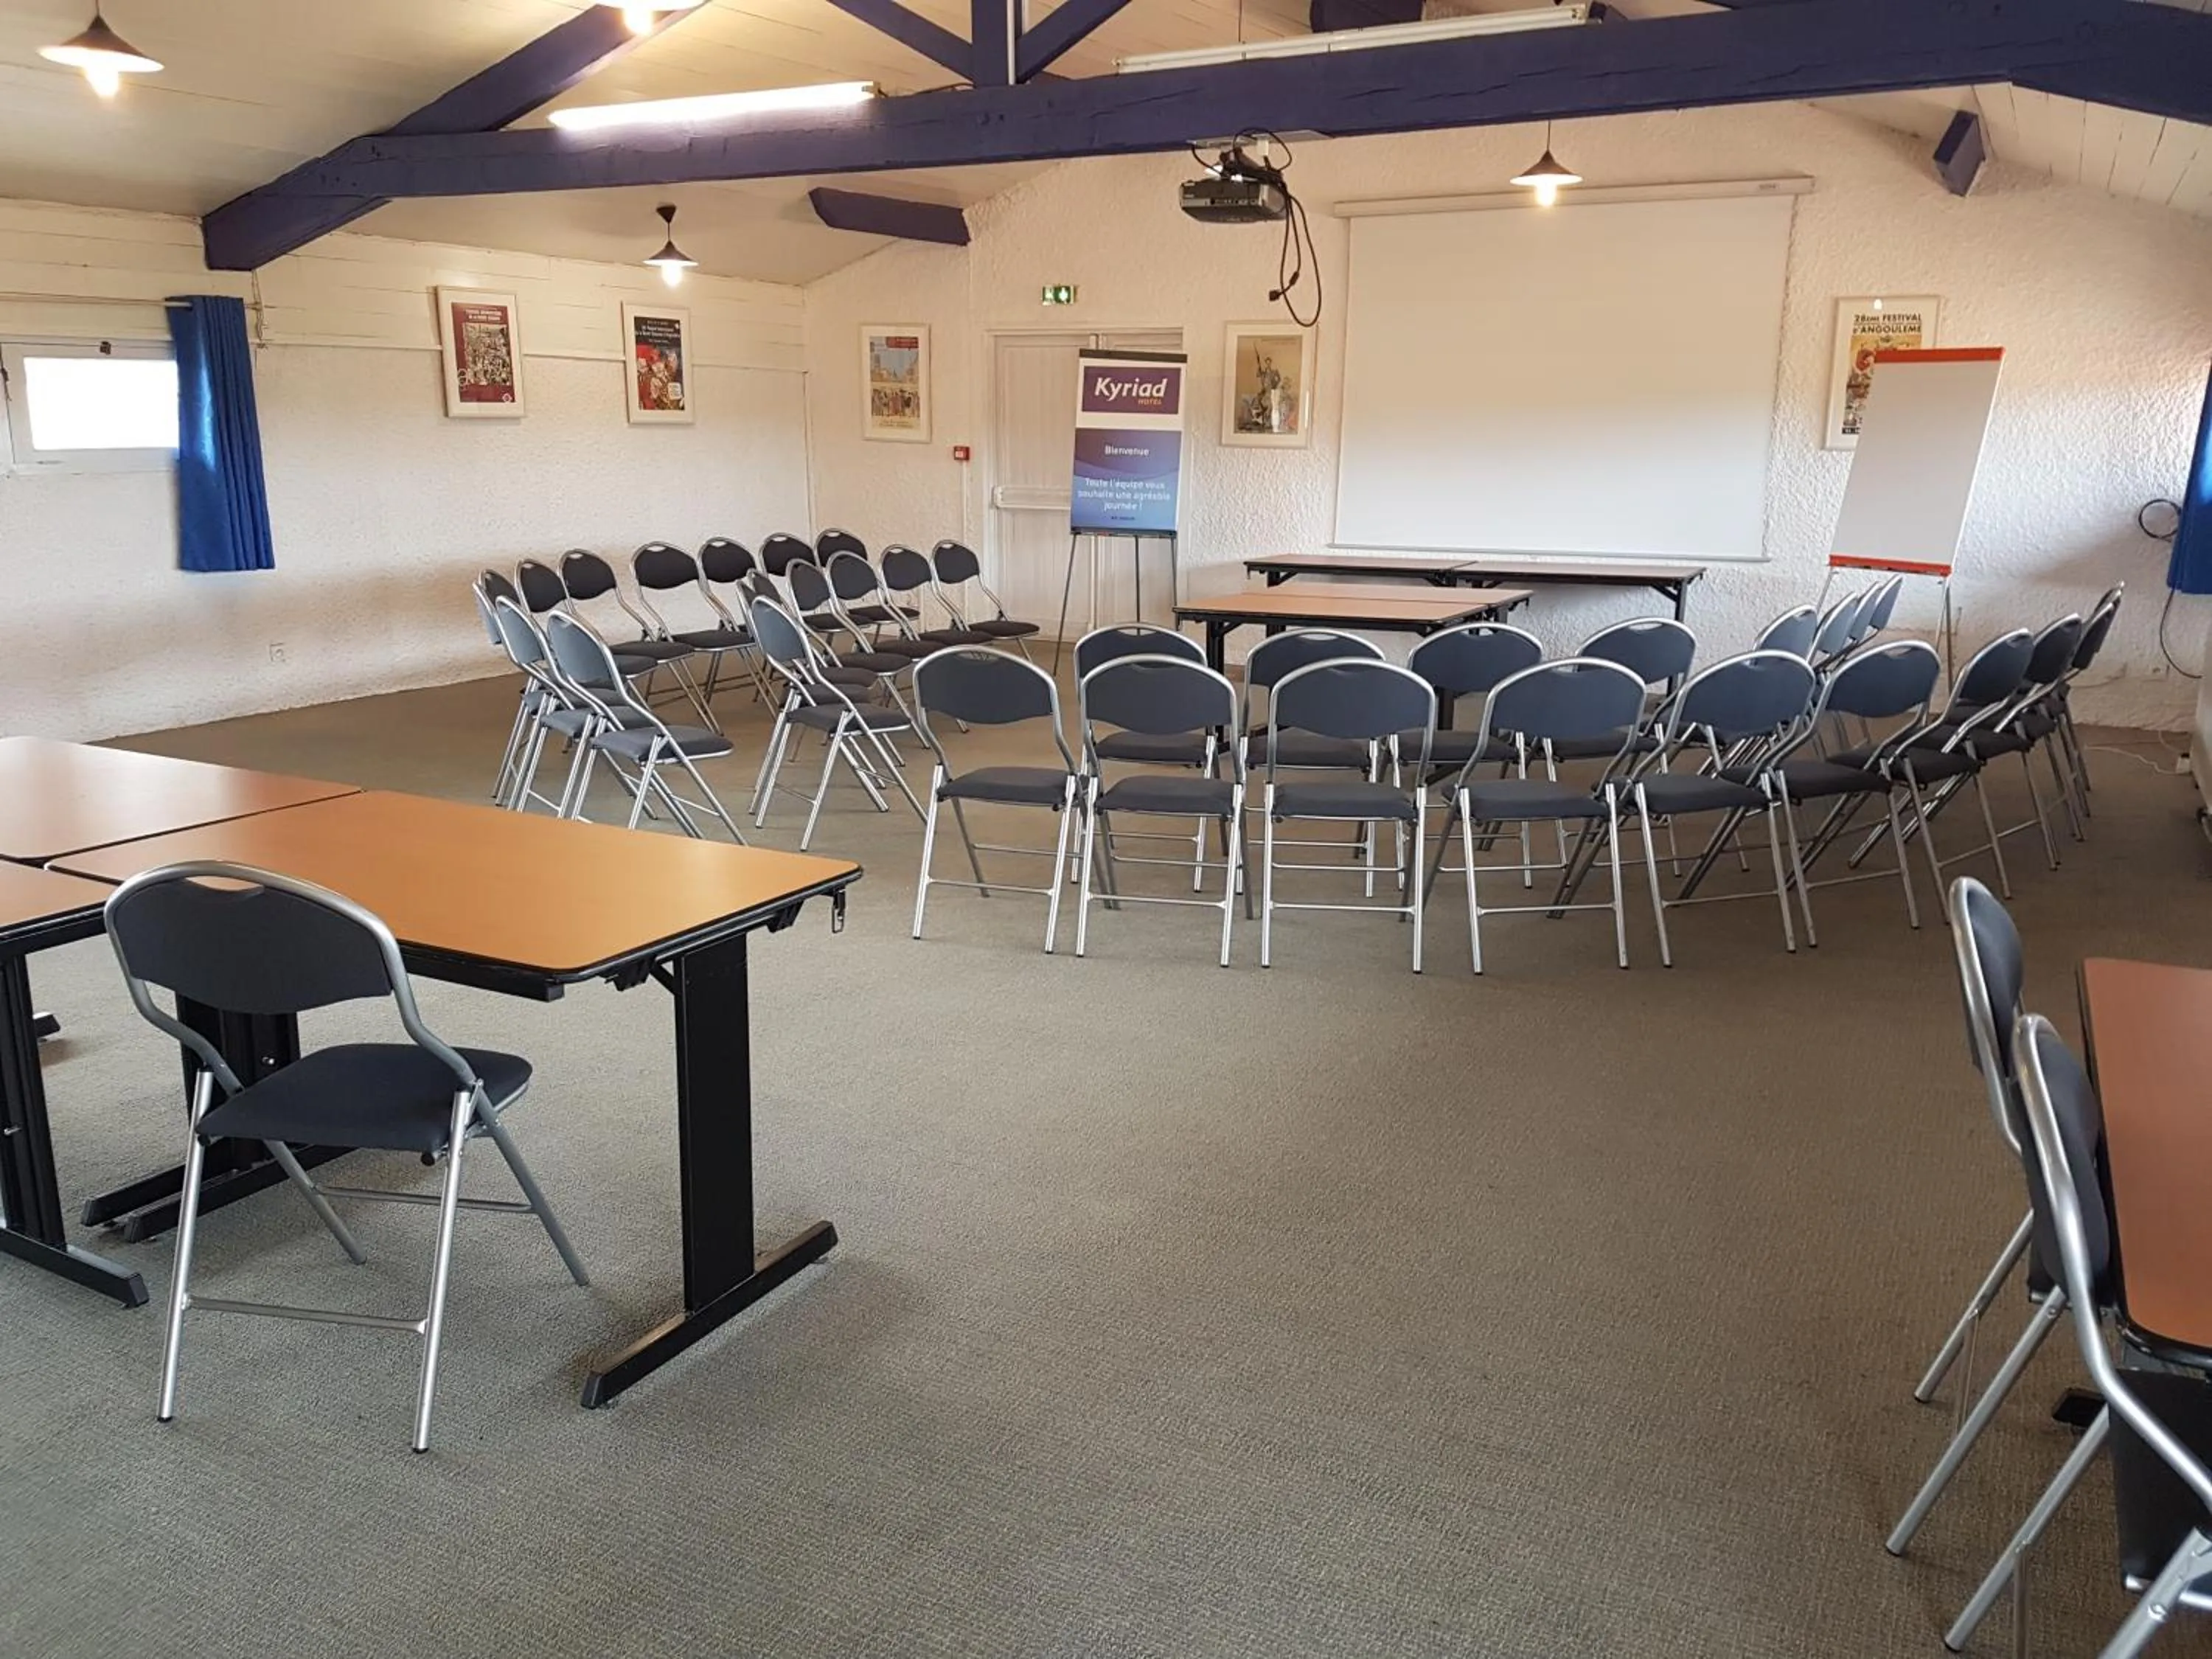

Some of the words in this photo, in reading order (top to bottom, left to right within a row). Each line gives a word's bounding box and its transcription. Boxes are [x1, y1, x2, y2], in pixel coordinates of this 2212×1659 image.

[1882, 313, 1921, 321] FESTIVAL
[1094, 377, 1168, 401] Kyriad
[1105, 445, 1150, 456] Bienvenue
[1085, 478, 1107, 487] Toute
[1078, 490, 1114, 498] souhaite
[1133, 492, 1171, 501] agréable
[1104, 502, 1138, 513] journée
